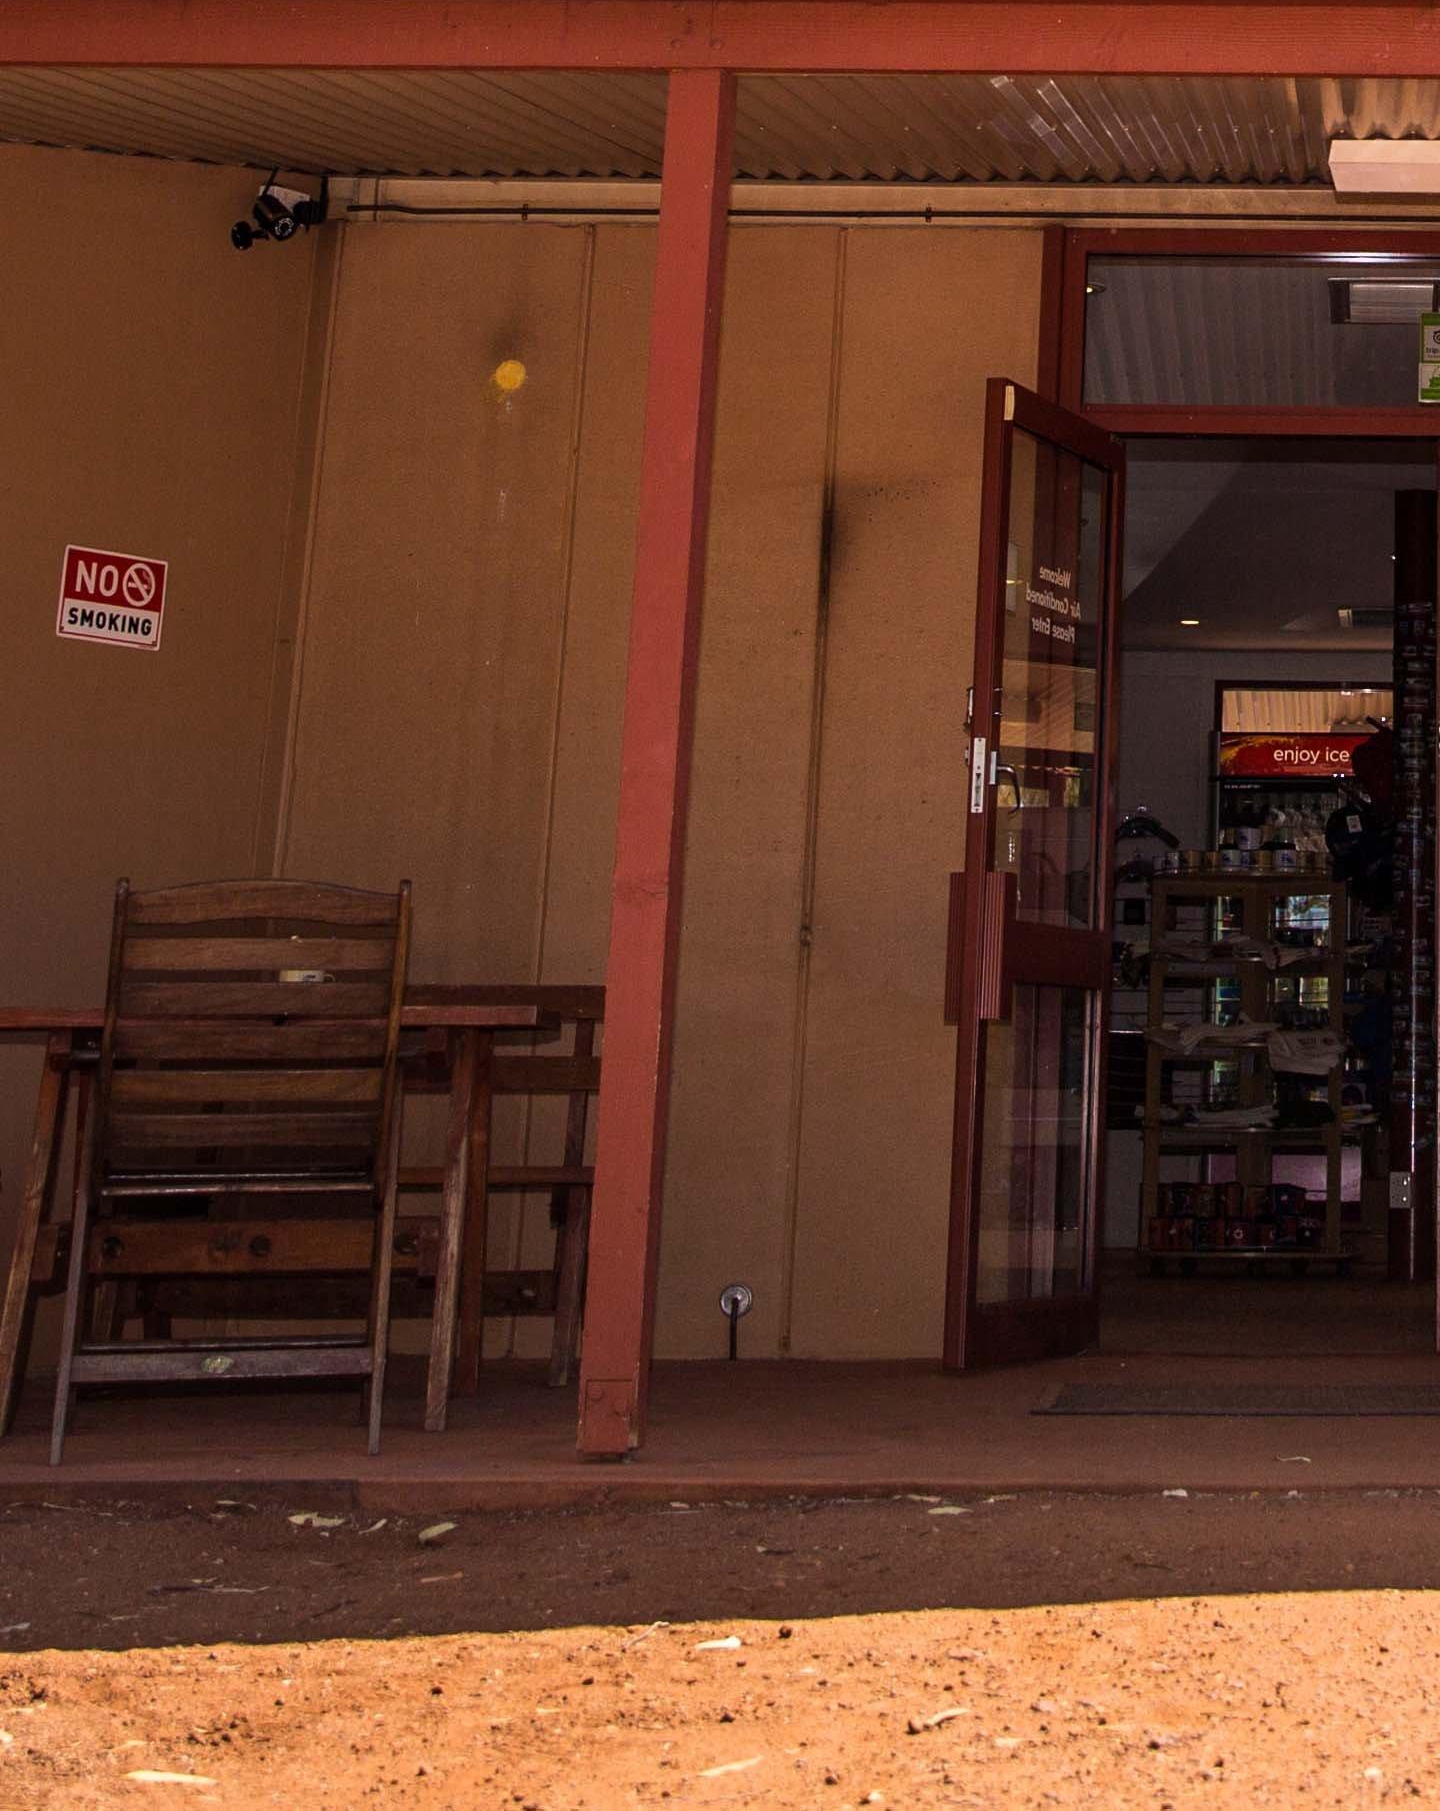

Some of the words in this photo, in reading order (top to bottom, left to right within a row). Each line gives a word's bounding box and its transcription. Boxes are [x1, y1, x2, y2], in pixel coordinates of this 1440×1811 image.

[75, 560, 119, 597] NO
[68, 607, 153, 636] SMOKING
[1273, 746, 1321, 765] enjoy
[1325, 746, 1351, 762] ice
